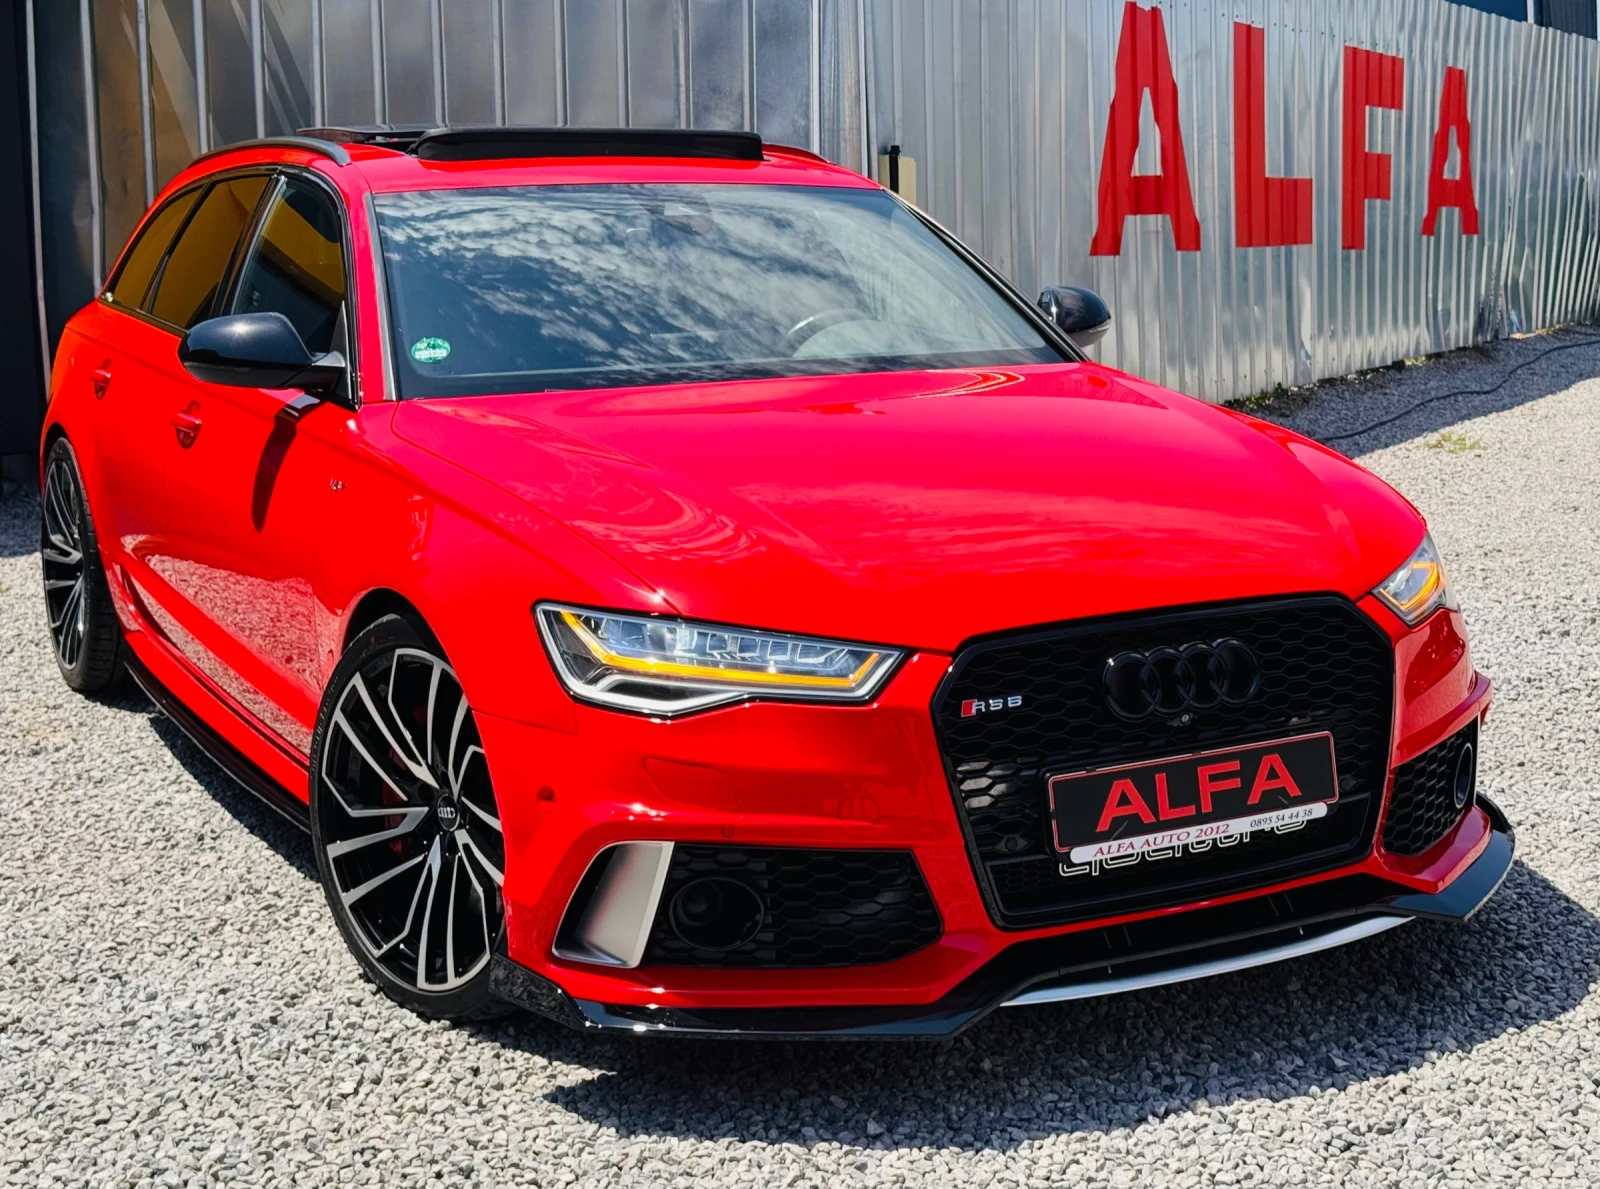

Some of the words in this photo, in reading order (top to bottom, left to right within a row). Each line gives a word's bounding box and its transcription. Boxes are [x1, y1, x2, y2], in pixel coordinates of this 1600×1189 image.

[1089, 1, 1479, 256] ALFA
[1095, 753, 1302, 832] ALFA
[1250, 816, 1273, 828] 0895
[1274, 814, 1286, 824] 54
[1287, 811, 1300, 821] 44
[1301, 808, 1314, 818] 38
[1092, 839, 1135, 857] ALFA
[1139, 831, 1191, 850] AUTO
[1193, 823, 1230, 840] 2012
